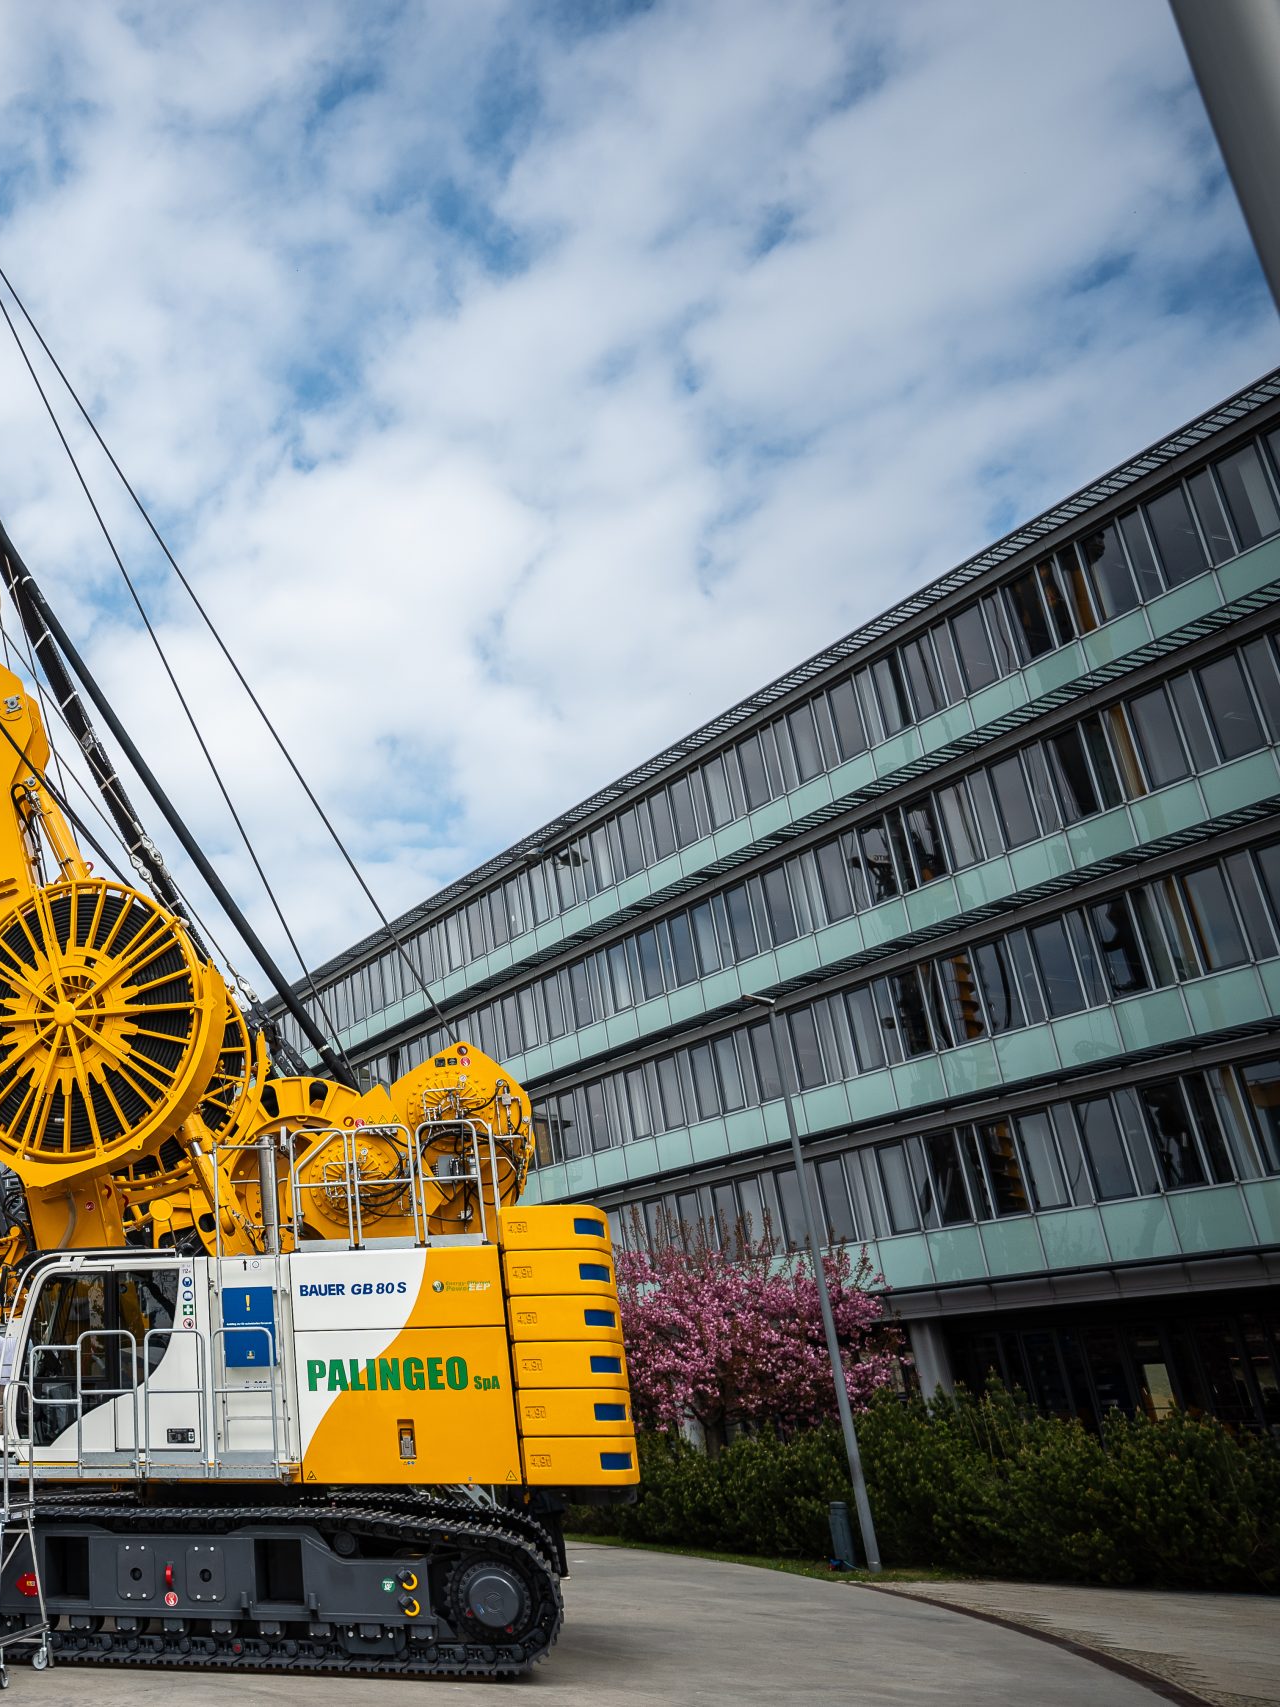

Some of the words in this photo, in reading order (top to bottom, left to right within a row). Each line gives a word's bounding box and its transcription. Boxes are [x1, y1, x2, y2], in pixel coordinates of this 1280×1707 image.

[299, 1284, 345, 1297] BAUER
[351, 1283, 373, 1296] GB
[376, 1283, 394, 1295] 80
[396, 1282, 407, 1294] S
[306, 1356, 468, 1392] PALINGEO
[473, 1375, 500, 1391] SpA
